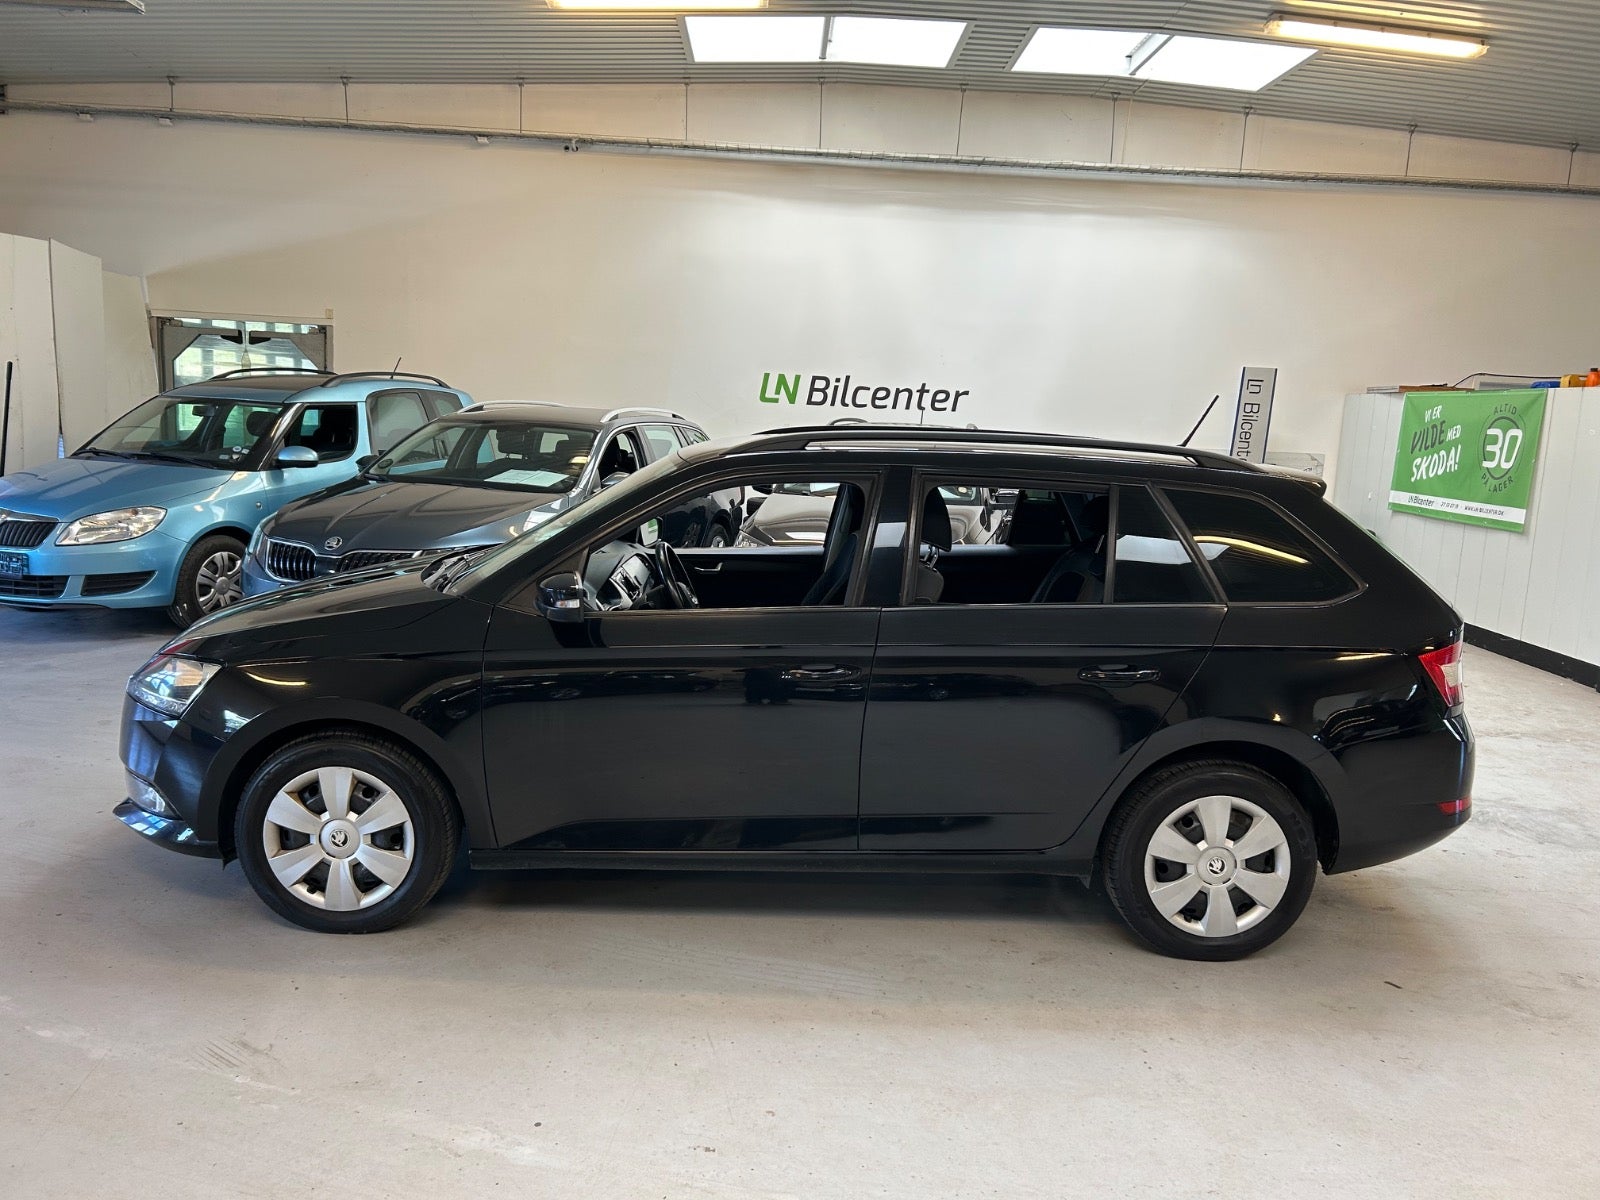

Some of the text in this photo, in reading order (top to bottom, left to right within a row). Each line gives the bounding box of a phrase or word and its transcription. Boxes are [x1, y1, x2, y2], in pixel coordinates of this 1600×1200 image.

[759, 372, 970, 412] LN Bilcenter
[1493, 403, 1517, 415] ALTID
[1424, 405, 1442, 423] VI ER
[1410, 420, 1461, 455] VILDE MED
[1482, 428, 1523, 469] 30
[1411, 444, 1461, 483] SKODA!
[1488, 475, 1513, 493] LAGER
